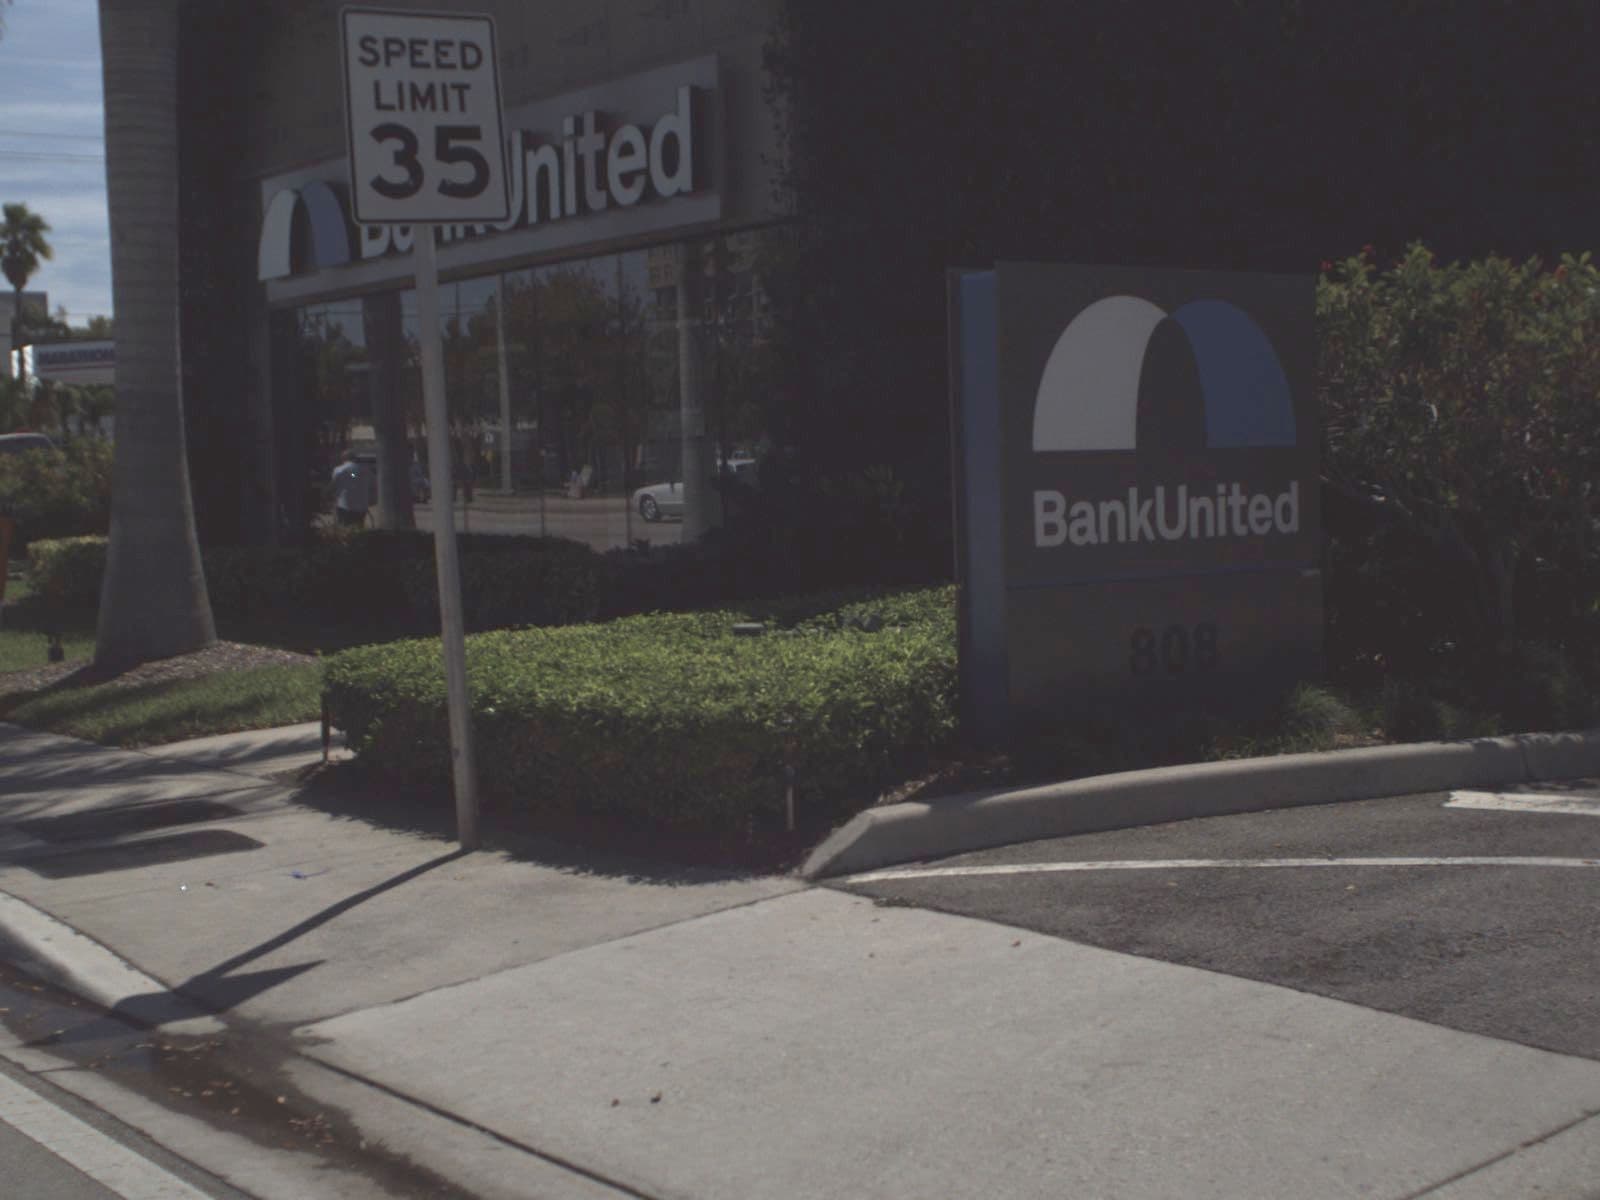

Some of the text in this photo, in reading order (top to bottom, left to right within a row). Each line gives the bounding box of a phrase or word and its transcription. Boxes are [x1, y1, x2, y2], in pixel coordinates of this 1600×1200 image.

[358, 37, 483, 71] SPEED
[374, 81, 472, 112] LIMIT
[361, 86, 691, 258] United
[369, 122, 490, 200] 35
[1034, 480, 1299, 547] BankUnited
